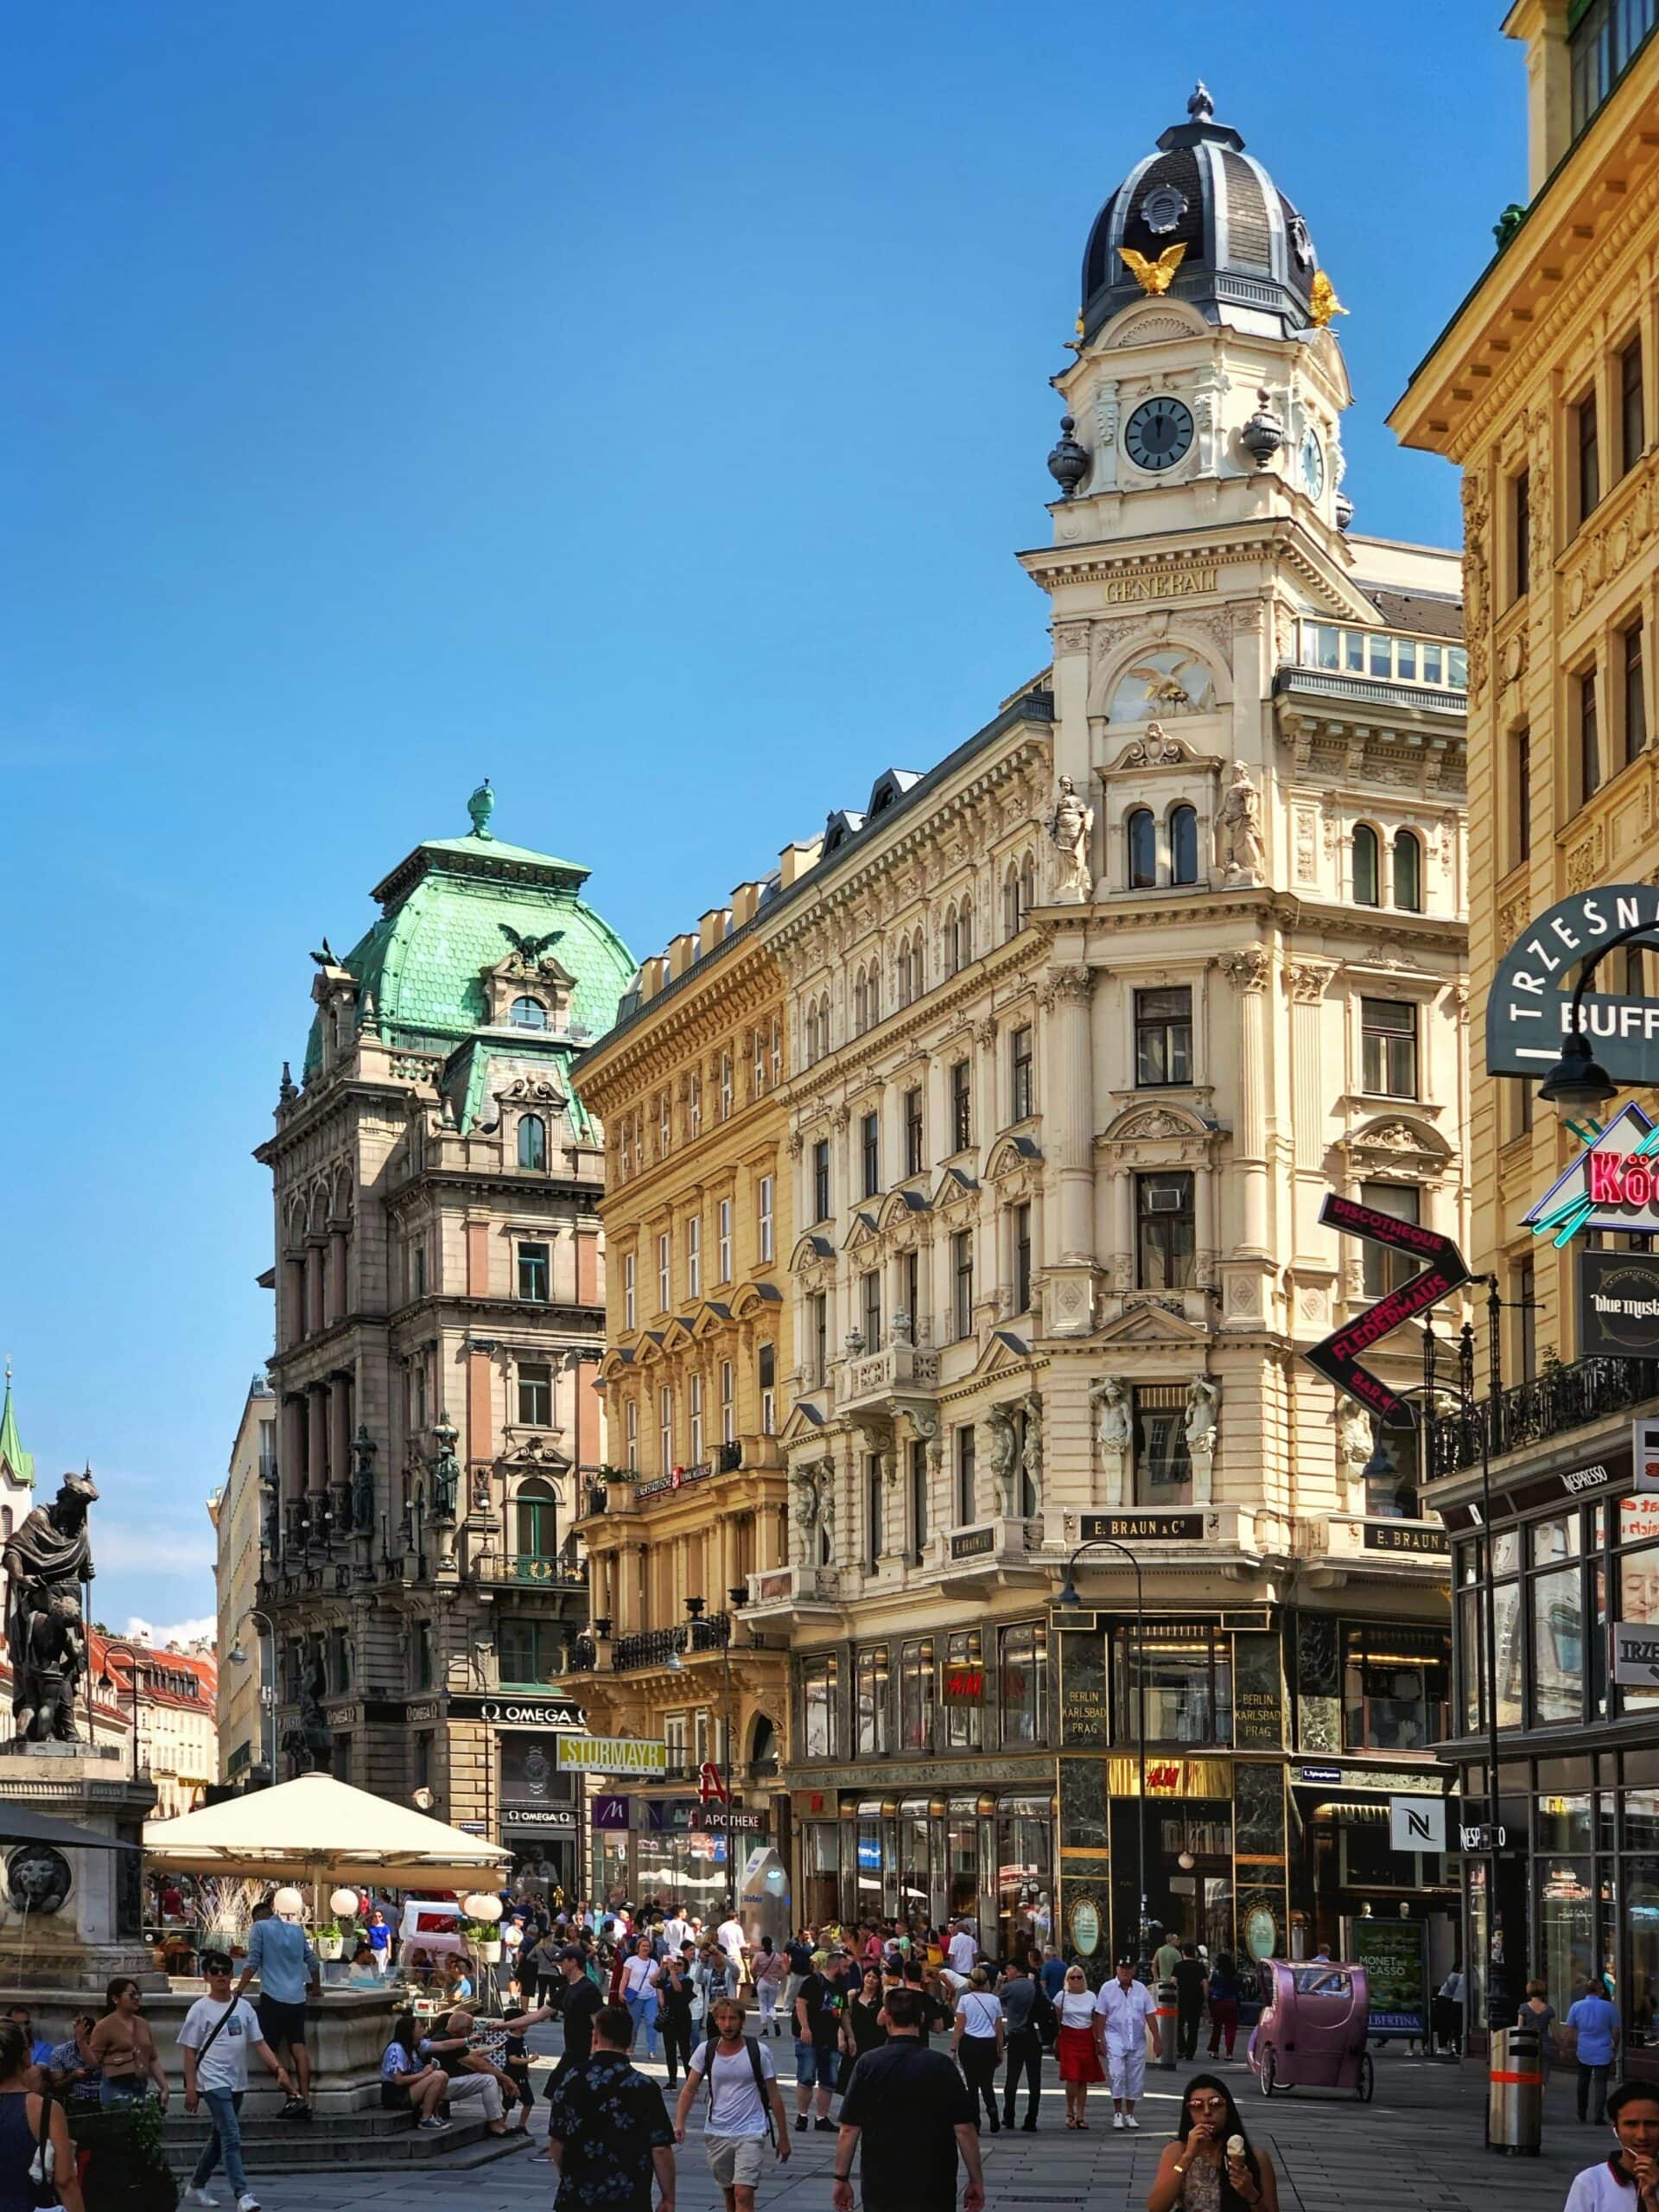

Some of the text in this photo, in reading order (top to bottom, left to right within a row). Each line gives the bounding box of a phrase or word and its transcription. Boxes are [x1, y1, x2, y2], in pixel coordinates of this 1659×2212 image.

[1105, 569, 1217, 604] GENERALI
[1510, 897, 1659, 1021] TRZEŚN
[1590, 1151, 1659, 1206] Kö
[1333, 1200, 1446, 1251] DISCOTHEQUE
[1590, 1294, 1622, 1313] blue
[1332, 1274, 1450, 1363] FLEDERMAUS
[1559, 1465, 1608, 1494] NESPRESSO
[1094, 1521, 1106, 1535] E.
[1111, 1521, 1156, 1535] BRAUN
[1394, 1531, 1439, 1548] BRAUN
[1070, 1691, 1098, 1702] BERLIN
[1243, 1694, 1273, 1705] BERLIN
[505, 1707, 572, 1723] OMEGA
[1062, 1707, 1106, 1718] KARLSBAD
[1235, 1710, 1281, 1720] KARLSBAD
[1072, 1722, 1097, 1733] PRAG
[1245, 1726, 1272, 1737] PRAG
[567, 1739, 658, 1767] STURMAYR
[521, 1813, 557, 1822] OMEGA
[705, 1814, 760, 1828] APOTHEKE
[1459, 1823, 1505, 1852] NESPO
[1358, 1956, 1396, 1966] MONET
[1365, 1966, 1405, 1976] ICASSO
[1368, 2014, 1419, 2027] LBERTINA
